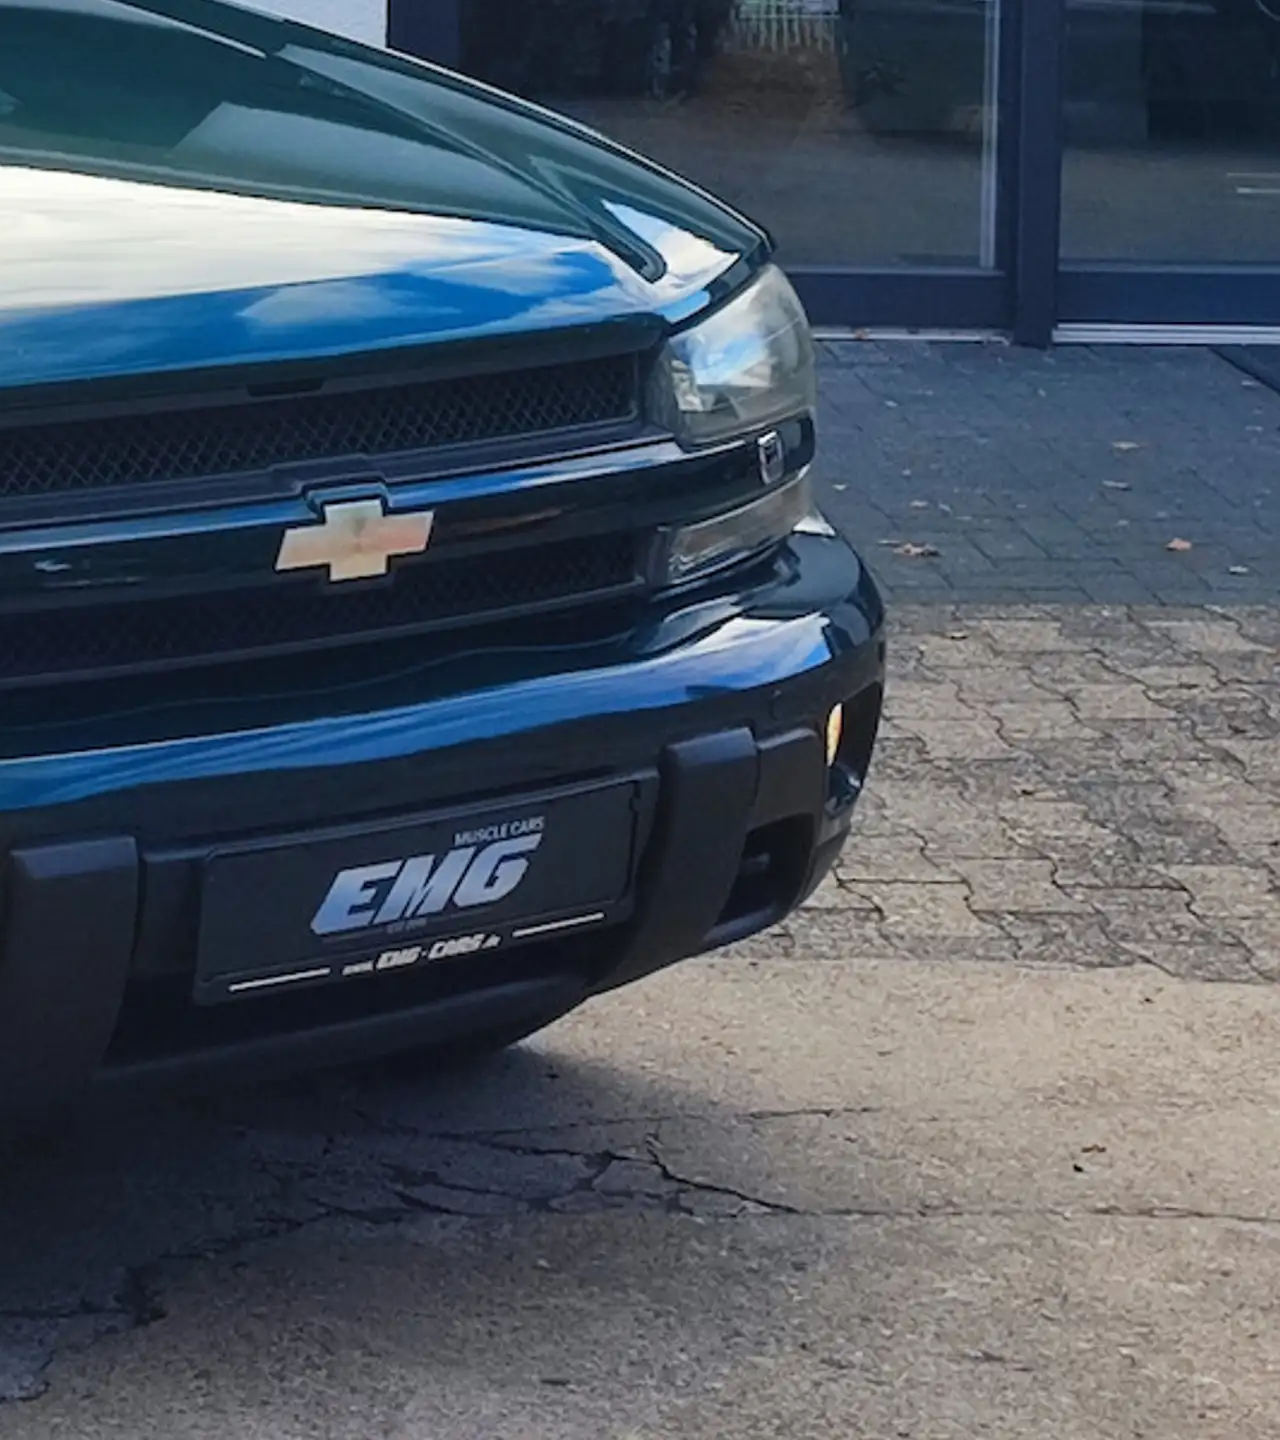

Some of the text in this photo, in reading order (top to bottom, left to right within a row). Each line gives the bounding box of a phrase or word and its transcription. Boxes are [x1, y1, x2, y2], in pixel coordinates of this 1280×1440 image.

[453, 815, 545, 847] MUSCLE CARS
[310, 832, 543, 936] EMG
